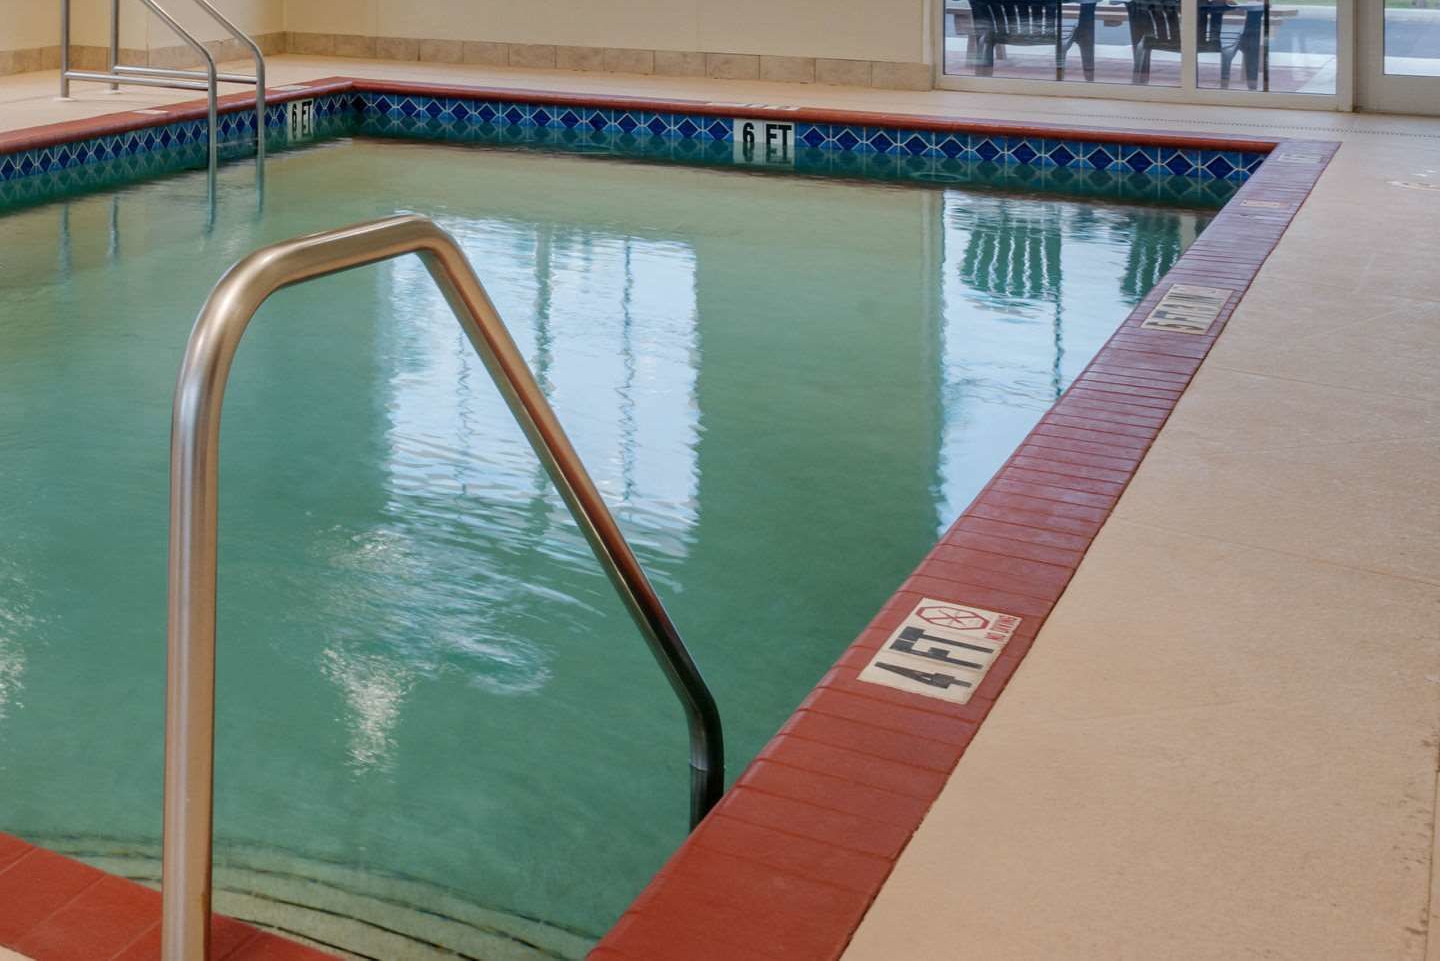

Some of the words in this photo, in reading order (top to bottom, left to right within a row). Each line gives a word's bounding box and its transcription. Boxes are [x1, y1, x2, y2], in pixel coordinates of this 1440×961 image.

[301, 100, 313, 118] FT
[743, 122, 755, 144] 6
[765, 123, 792, 145] FT
[888, 626, 994, 670] FT
[874, 661, 973, 689] 4
